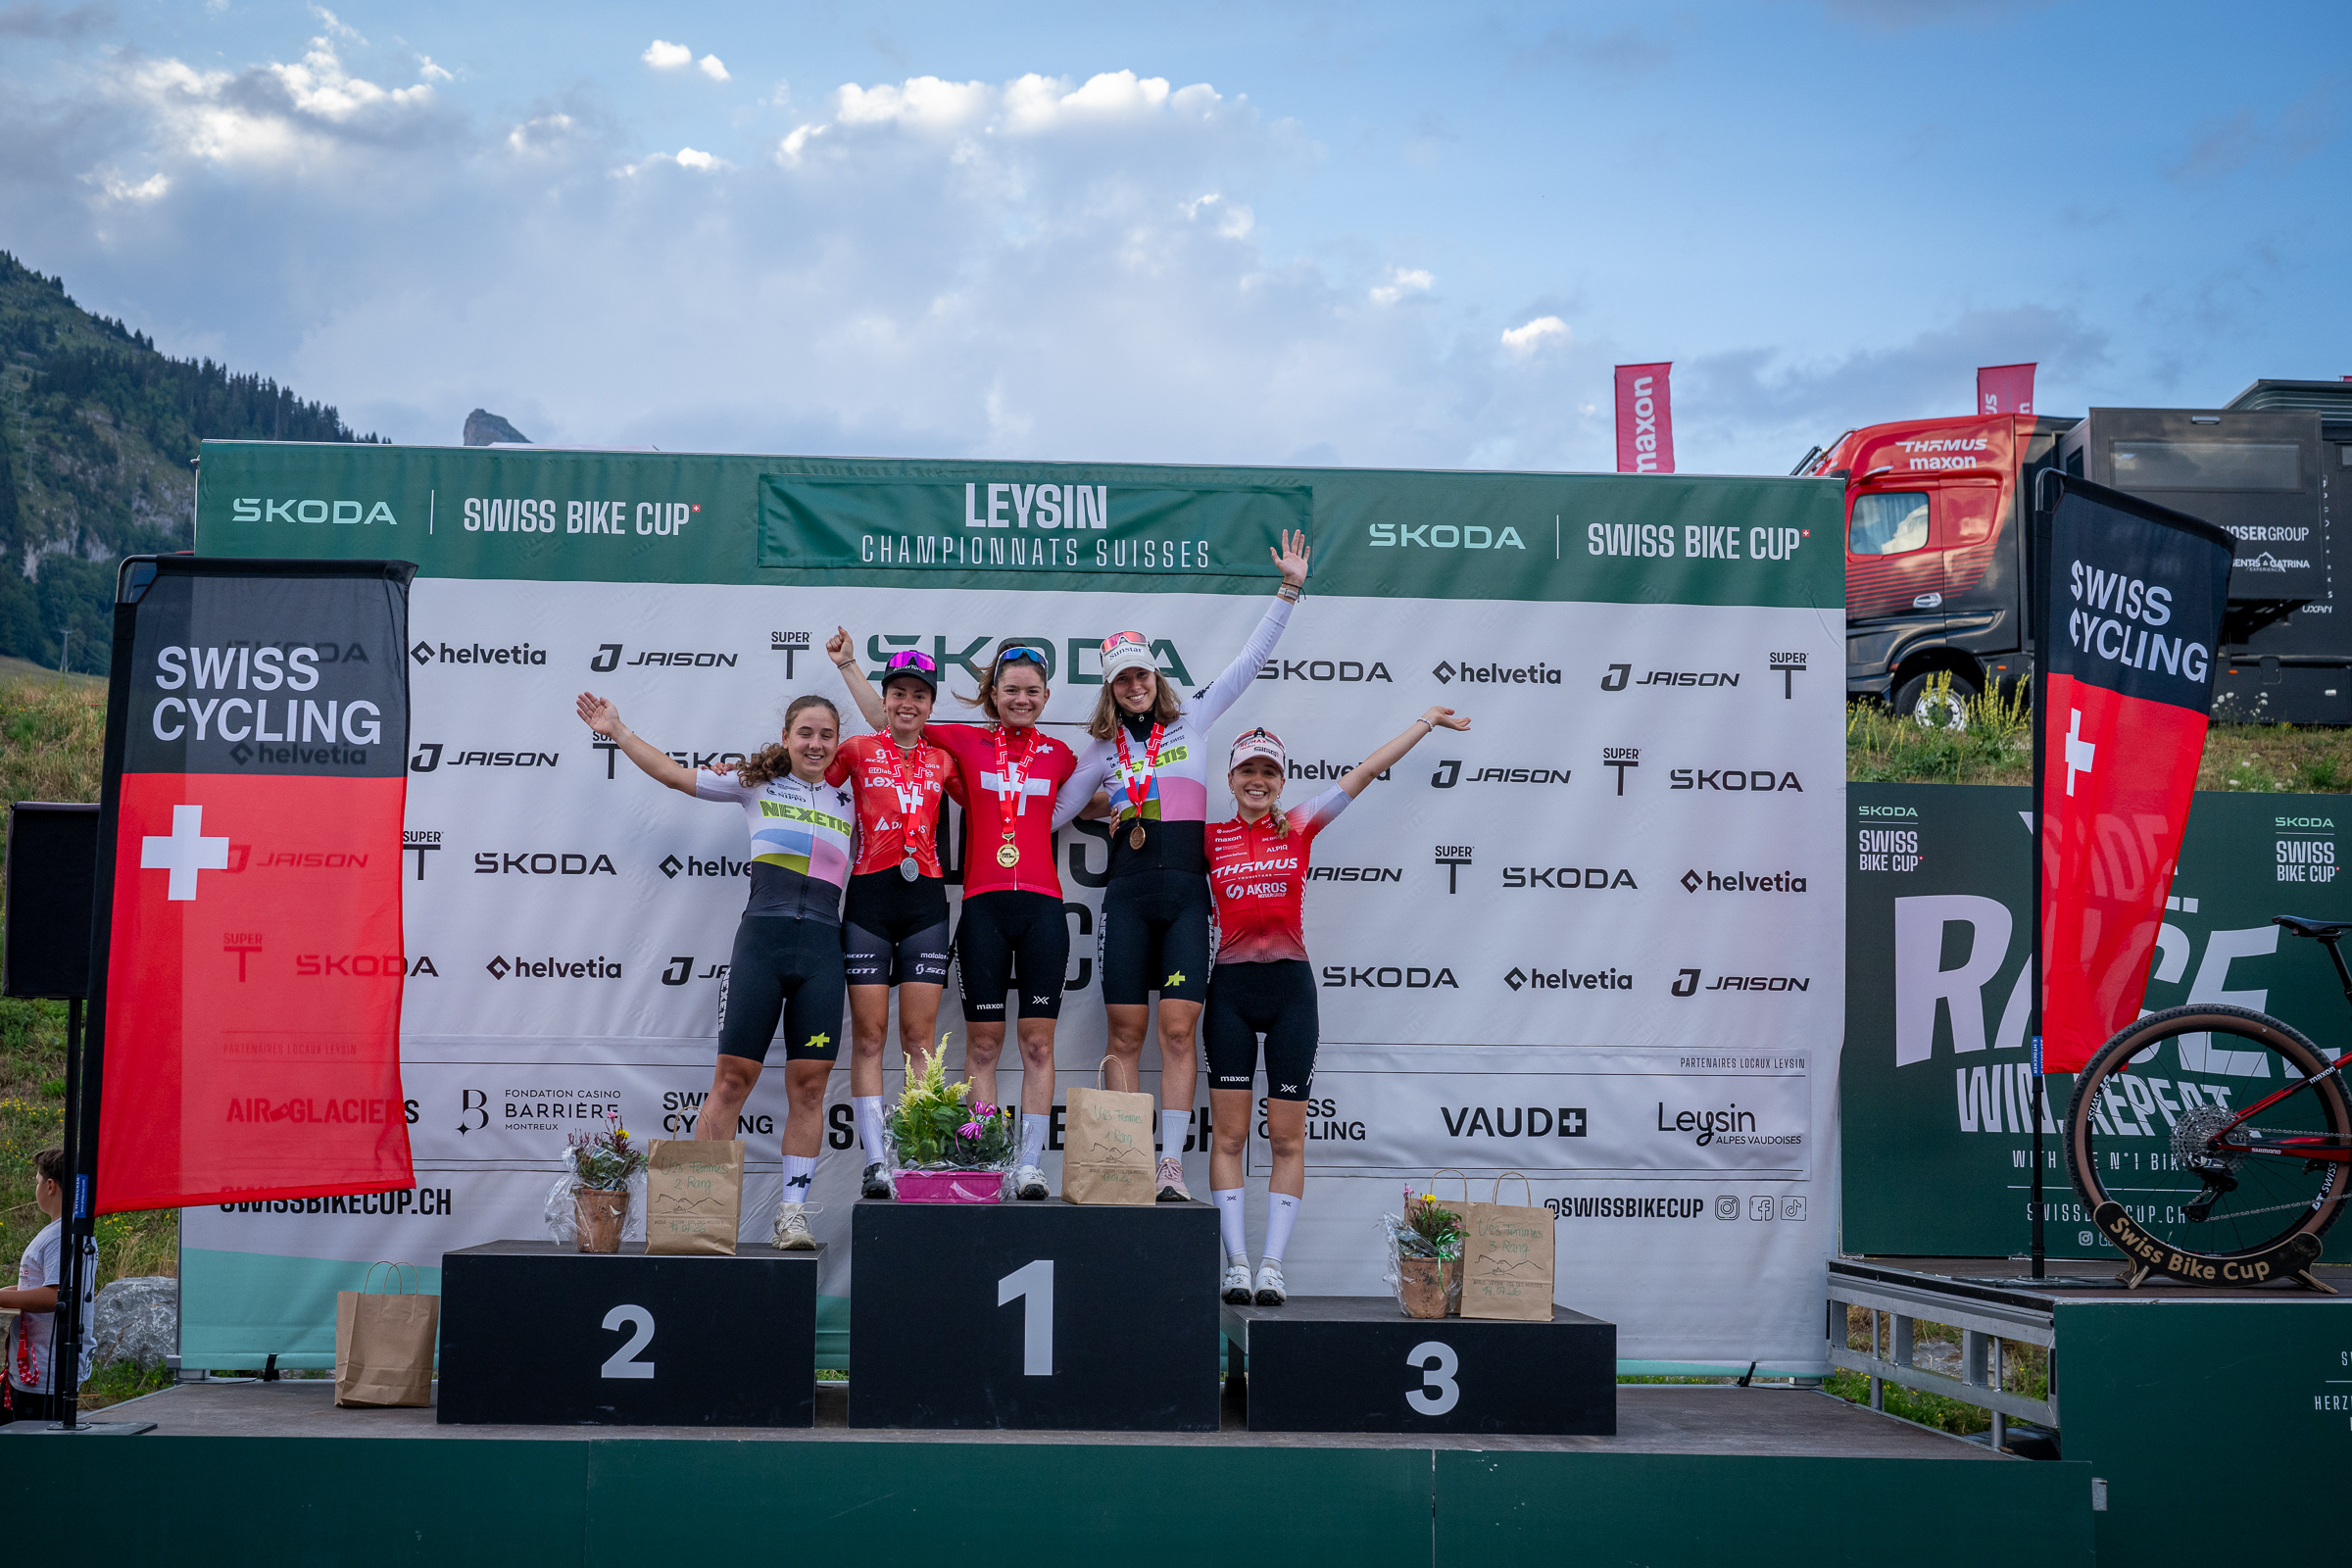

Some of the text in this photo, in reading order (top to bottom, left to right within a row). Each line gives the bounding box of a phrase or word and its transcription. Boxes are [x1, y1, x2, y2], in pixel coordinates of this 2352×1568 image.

[1909, 455, 1978, 470] maxon
[464, 497, 690, 536] SWISS BIKE CUP
[965, 482, 1107, 529] LEYSIN
[861, 534, 1210, 568] CHAMPIONNATS SUISSES
[1588, 522, 1800, 561] SWISS BIKE CUP
[2070, 559, 2173, 626] SWISS
[771, 631, 809, 644] SUPER
[2069, 607, 2209, 684] CYCLING
[439, 641, 547, 666] helvetia
[626, 651, 738, 668] JAISON
[771, 644, 810, 680] T
[1769, 652, 1807, 664] SUPER
[155, 646, 319, 692] SWISS
[1460, 661, 1562, 685] helvetia
[1636, 670, 1740, 687] JAISON
[1769, 664, 1807, 700] T
[152, 697, 381, 746] CYCLING
[447, 751, 560, 768] JAISON
[1603, 748, 1640, 760] SUPER
[1465, 767, 1572, 784] JAISON
[1603, 760, 1640, 797] T
[761, 801, 852, 838] NEXETIS
[403, 830, 441, 843] SUPER
[1858, 829, 1919, 854] SWISS
[403, 844, 441, 881] T
[1435, 845, 1473, 858] SUPER
[1859, 854, 1919, 872] BIKE CUP
[2276, 840, 2335, 864] SWISS
[688, 855, 752, 877] helve
[1434, 858, 1473, 895] T
[2277, 864, 2336, 883] BIKE CUP
[1247, 882, 1288, 896] AKROS
[1706, 870, 1808, 894] helvetia
[514, 956, 622, 980] helvetia
[1531, 966, 1633, 991] helvetia
[1705, 975, 1810, 993] JAISON
[1680, 1056, 1805, 1070] PARTENAIRES LOCAUX LEYSIN
[2308, 1063, 2337, 1085] maxon
[505, 1089, 621, 1099] FONDATION CASINO
[505, 1101, 619, 1120] BARRIÈRE
[1441, 1106, 1554, 1138] VAUD
[505, 1122, 559, 1131] MONTREUX
[1657, 1102, 1756, 1148] Leysin
[1715, 1135, 1802, 1146] ALPES VAUDOISES
[2250, 1147, 2282, 1156] SHIMANO
[1544, 1197, 1704, 1221] @SWISSBIKECUP
[2110, 1217, 2270, 1282] Swiss Bike Cup
[997, 1259, 1054, 1376] 1
[601, 1303, 656, 1379] 2
[1404, 1340, 1460, 1416] 3
